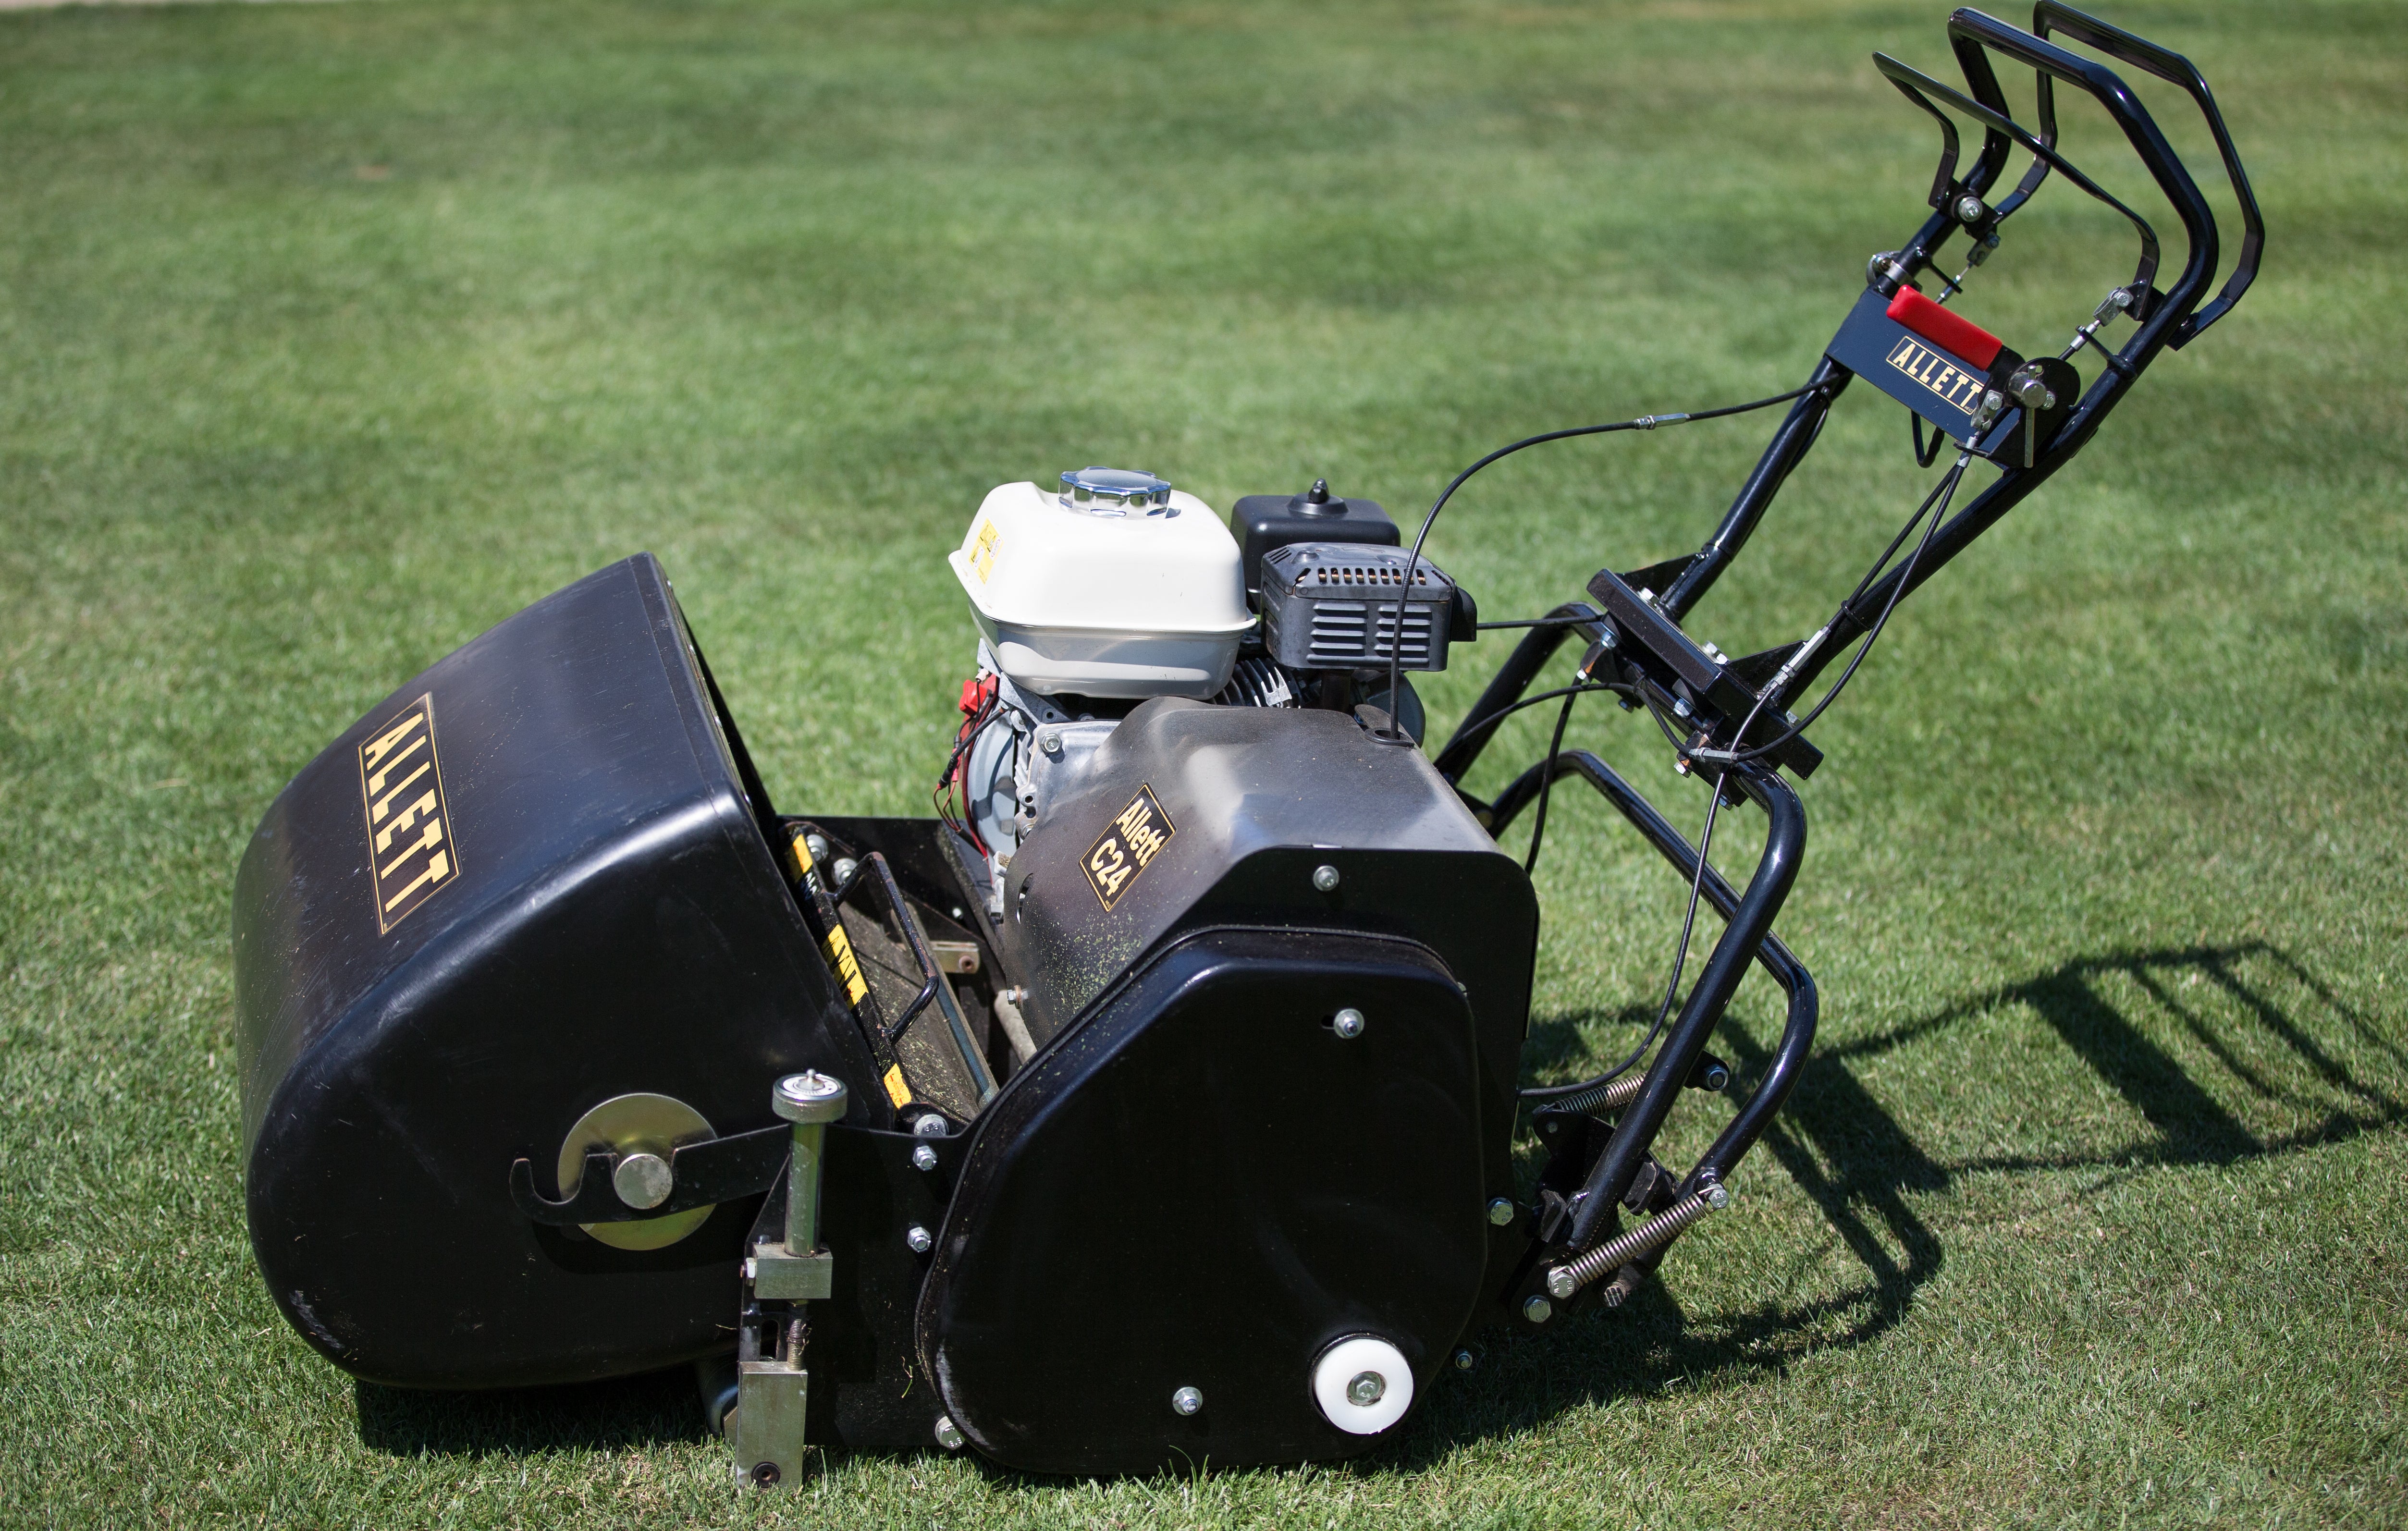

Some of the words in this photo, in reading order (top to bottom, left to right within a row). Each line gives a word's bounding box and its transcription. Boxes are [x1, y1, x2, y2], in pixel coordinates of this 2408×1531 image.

[1892, 343, 1983, 408] ALLETT
[365, 712, 449, 913] ALLETT
[1115, 797, 1166, 867] Allett
[1090, 838, 1132, 897] C24
